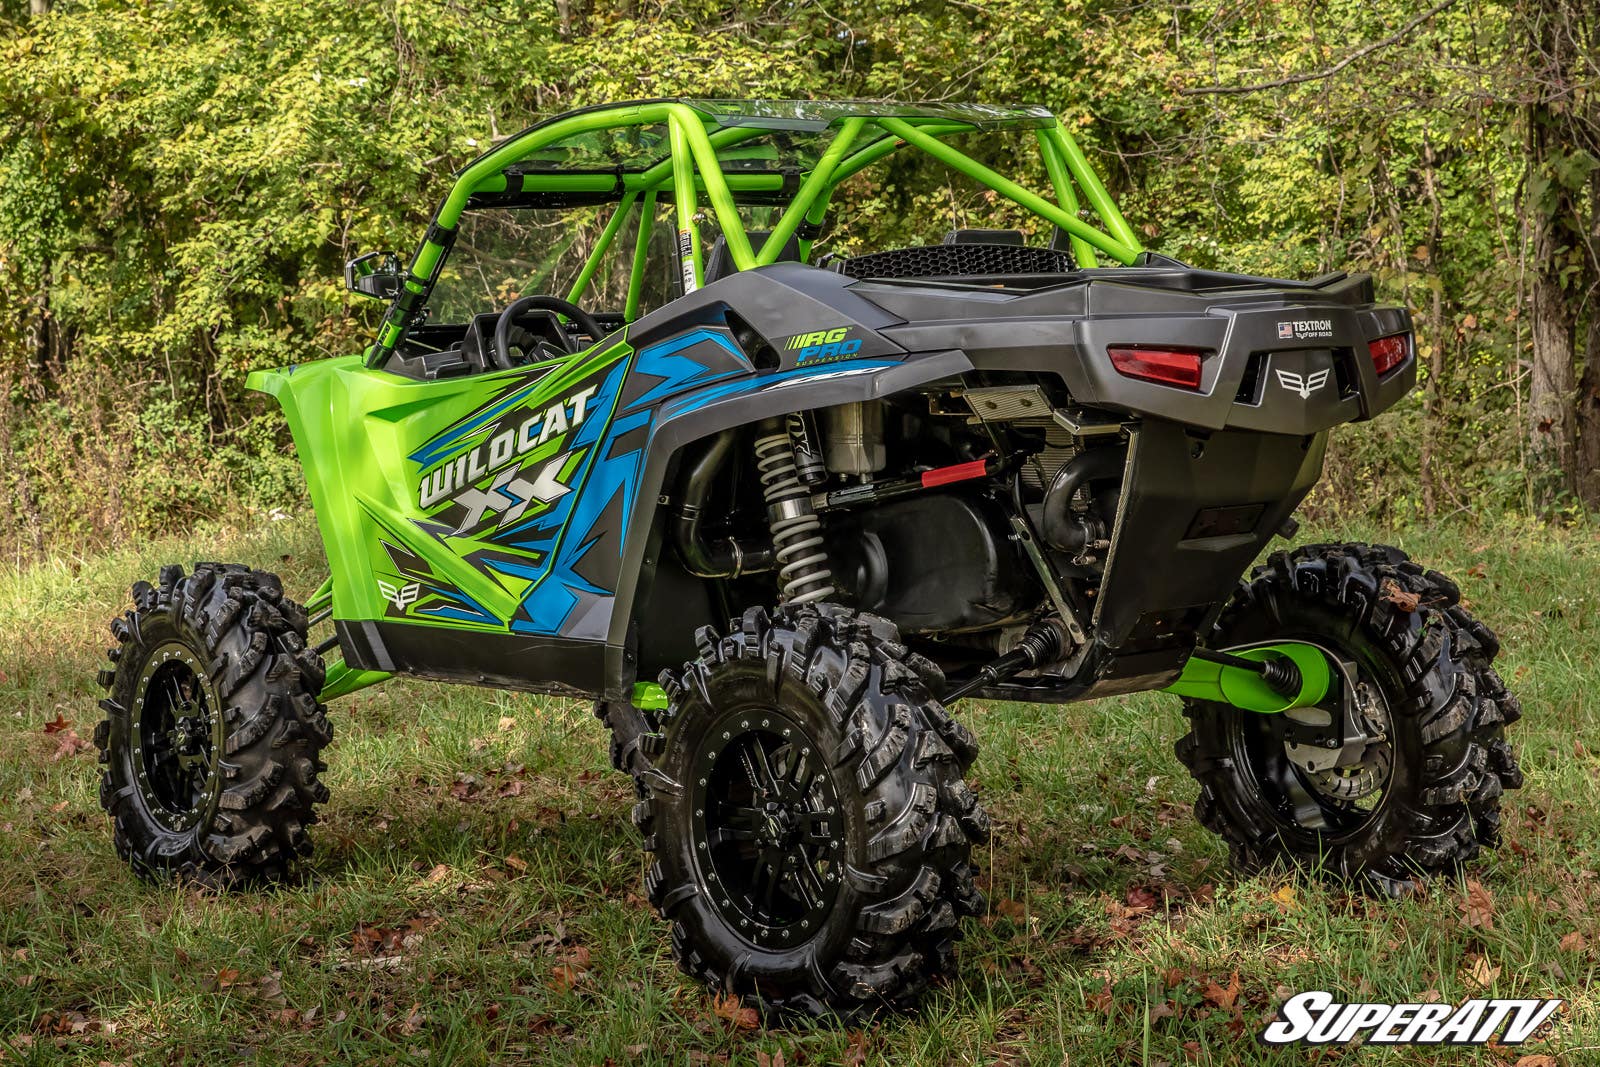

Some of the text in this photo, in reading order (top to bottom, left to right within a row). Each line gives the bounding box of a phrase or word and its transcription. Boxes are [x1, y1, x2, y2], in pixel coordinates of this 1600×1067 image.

[1292, 320, 1332, 332] TEXTRON
[795, 353, 859, 367] SUSPENSION
[796, 339, 863, 362] PRO
[419, 383, 598, 509] WILDCAT
[786, 410, 812, 456] OX
[450, 450, 573, 536] XX
